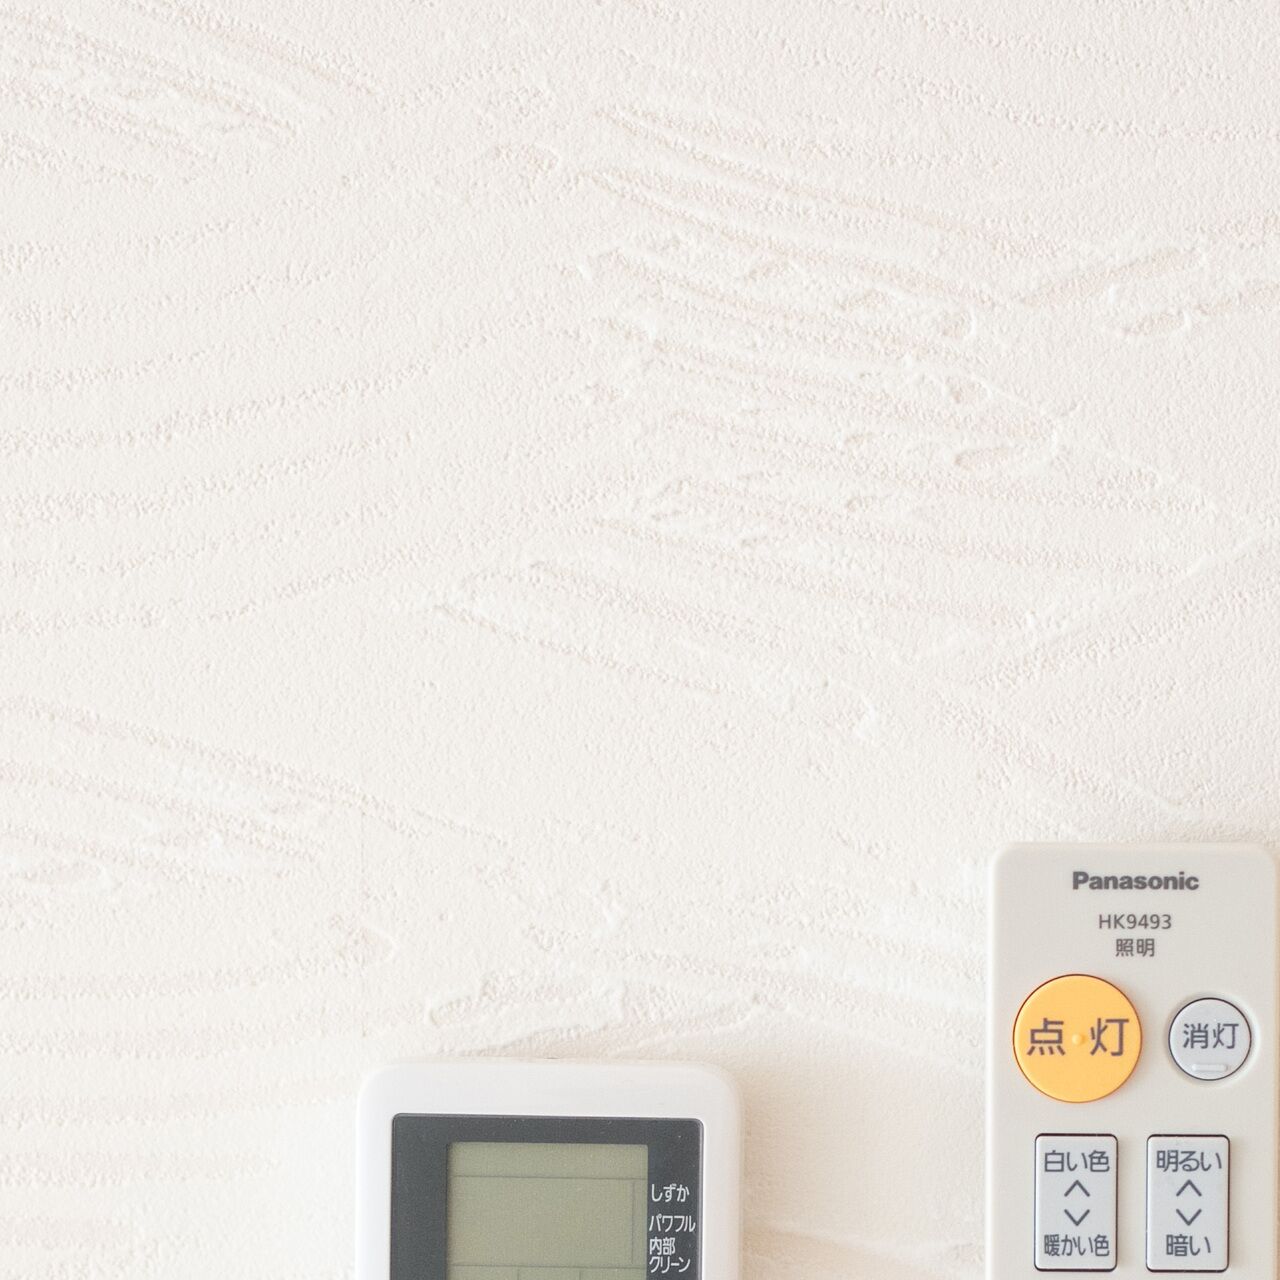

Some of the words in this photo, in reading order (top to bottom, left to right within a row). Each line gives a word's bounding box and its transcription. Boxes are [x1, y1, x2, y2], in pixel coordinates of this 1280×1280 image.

[1071, 870, 1201, 891] Panasonic
[1098, 913, 1173, 931] HK9493
[1114, 937, 1156, 958] 照明
[1182, 1022, 1240, 1050] 消灯
[1043, 1149, 1111, 1174] 白い色
[1156, 1149, 1223, 1173] 明るい
[649, 1183, 691, 1203] しずか
[648, 1214, 697, 1233] パワフル
[648, 1237, 676, 1256] 内部
[1043, 1233, 1111, 1258] 暖かい色
[1165, 1234, 1212, 1257] 暗い
[648, 1255, 691, 1275] クリーン
